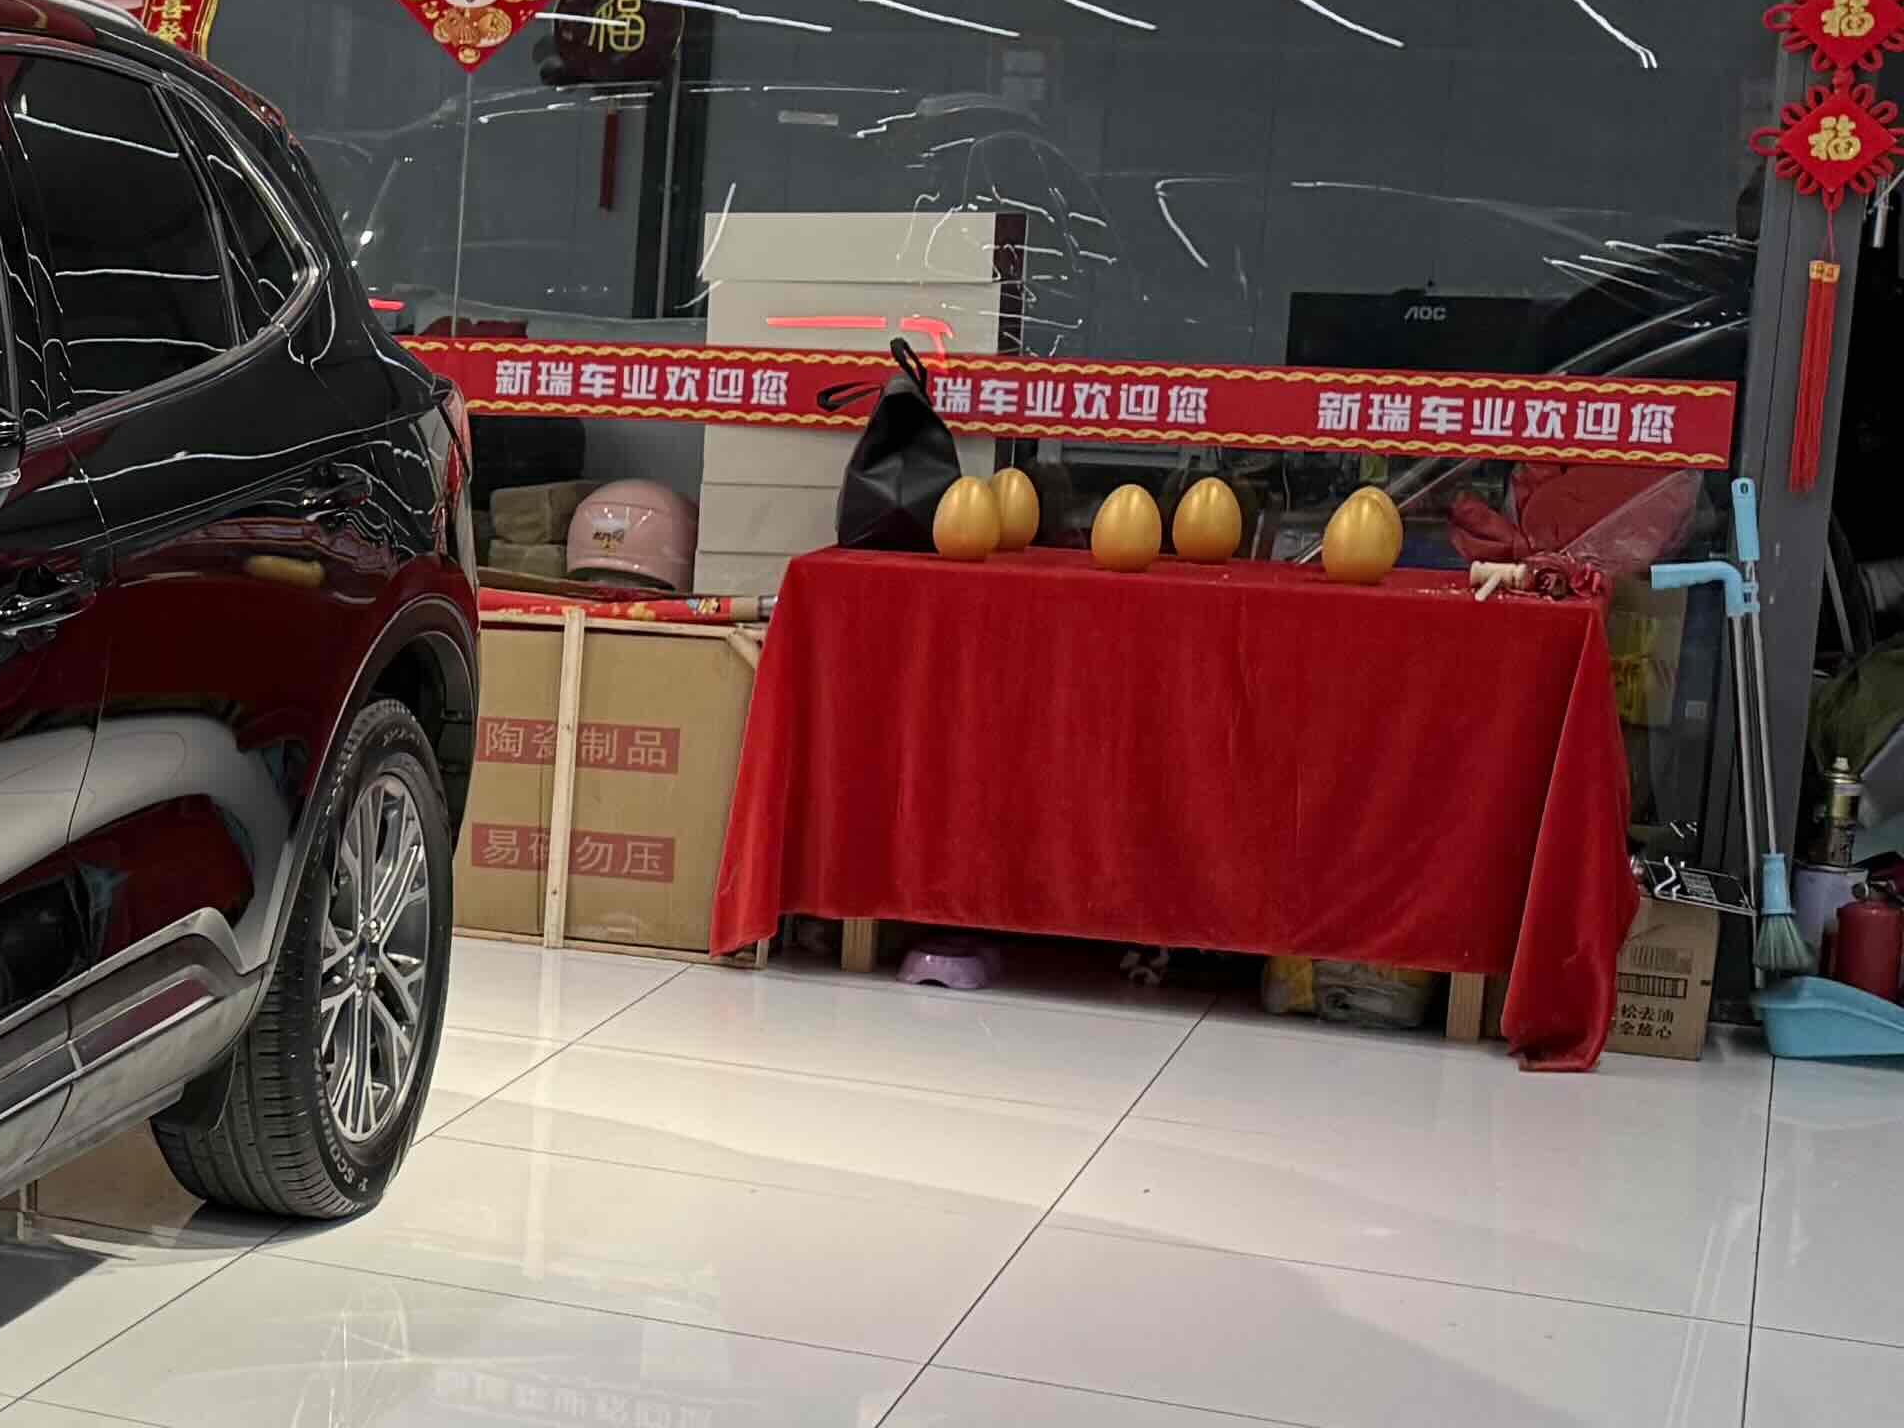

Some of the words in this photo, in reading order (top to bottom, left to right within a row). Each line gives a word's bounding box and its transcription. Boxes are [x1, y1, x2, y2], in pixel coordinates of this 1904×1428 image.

[1807, 114, 1862, 162] 福
[1404, 305, 1447, 322] AOC
[495, 360, 790, 406] 新瑞车业欢迎您
[1317, 391, 1677, 445] 新瑞车业欢迎您
